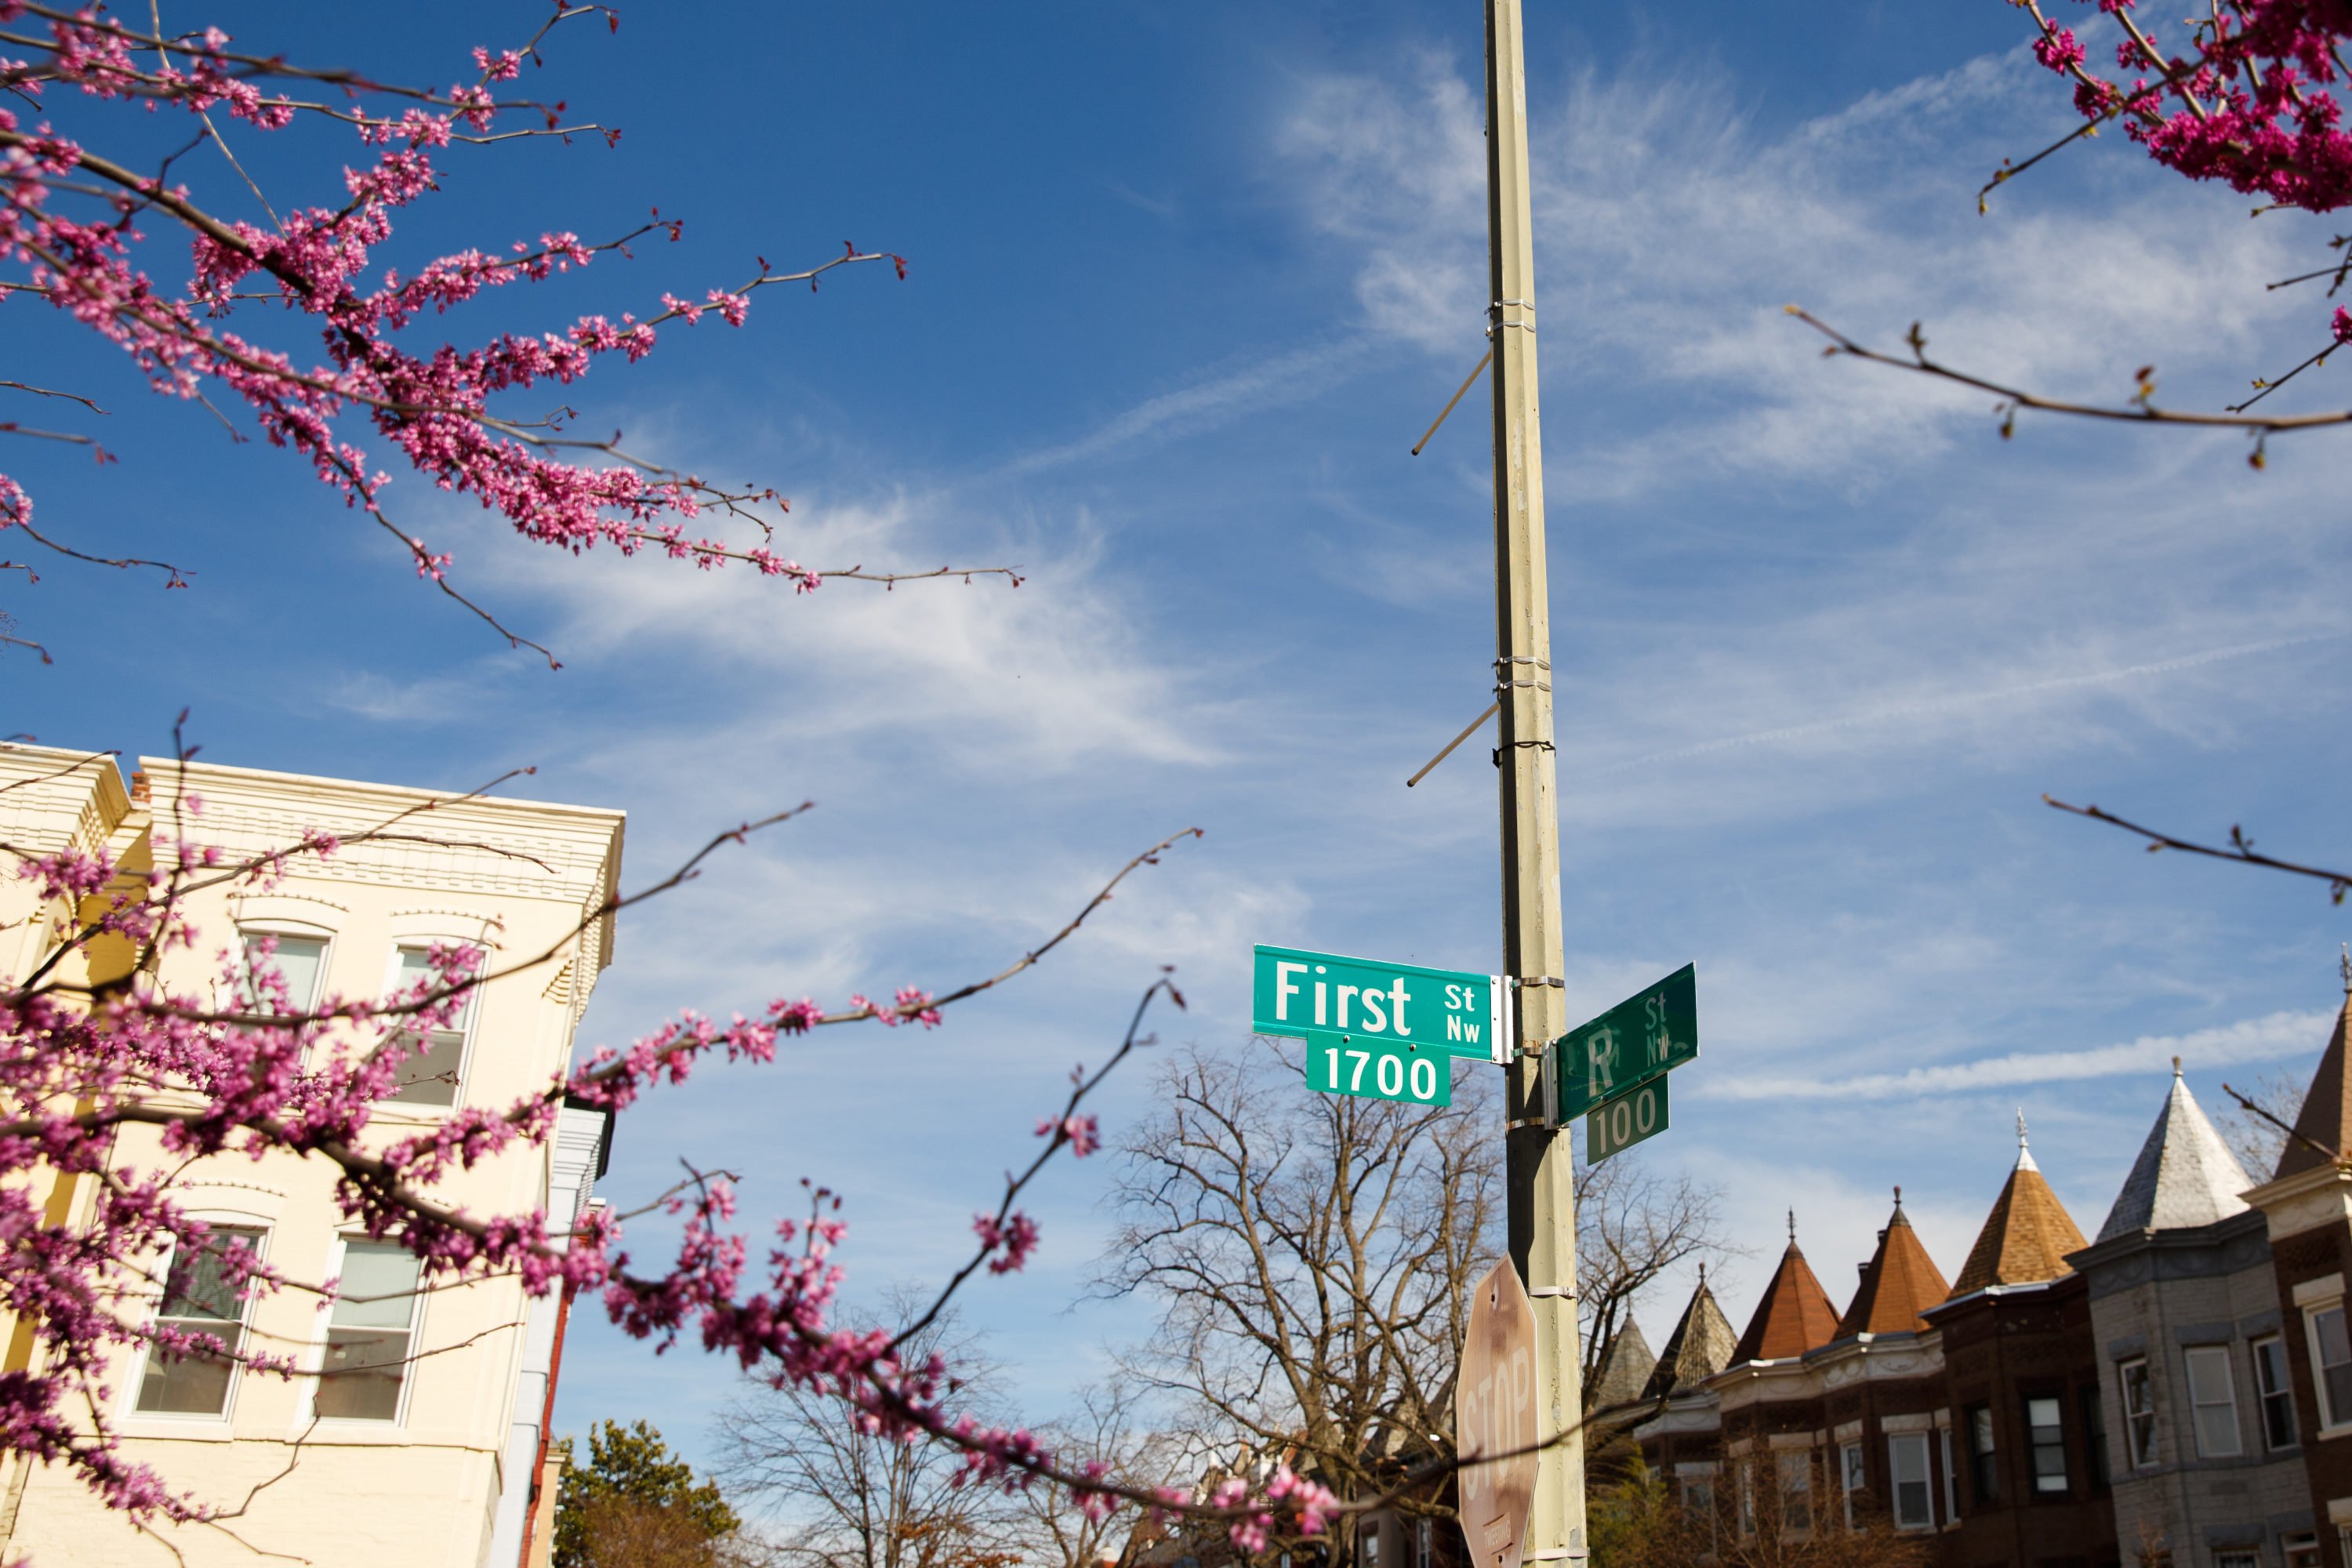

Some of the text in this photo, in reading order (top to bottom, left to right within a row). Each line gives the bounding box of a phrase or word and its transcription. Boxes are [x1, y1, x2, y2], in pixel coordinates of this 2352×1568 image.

[1276, 960, 1475, 1036] First St
[1325, 1047, 1436, 1100] 1700
[1588, 991, 1668, 1098] R St
[1596, 1088, 1656, 1154] 100
[1464, 1345, 1530, 1501] STOP
